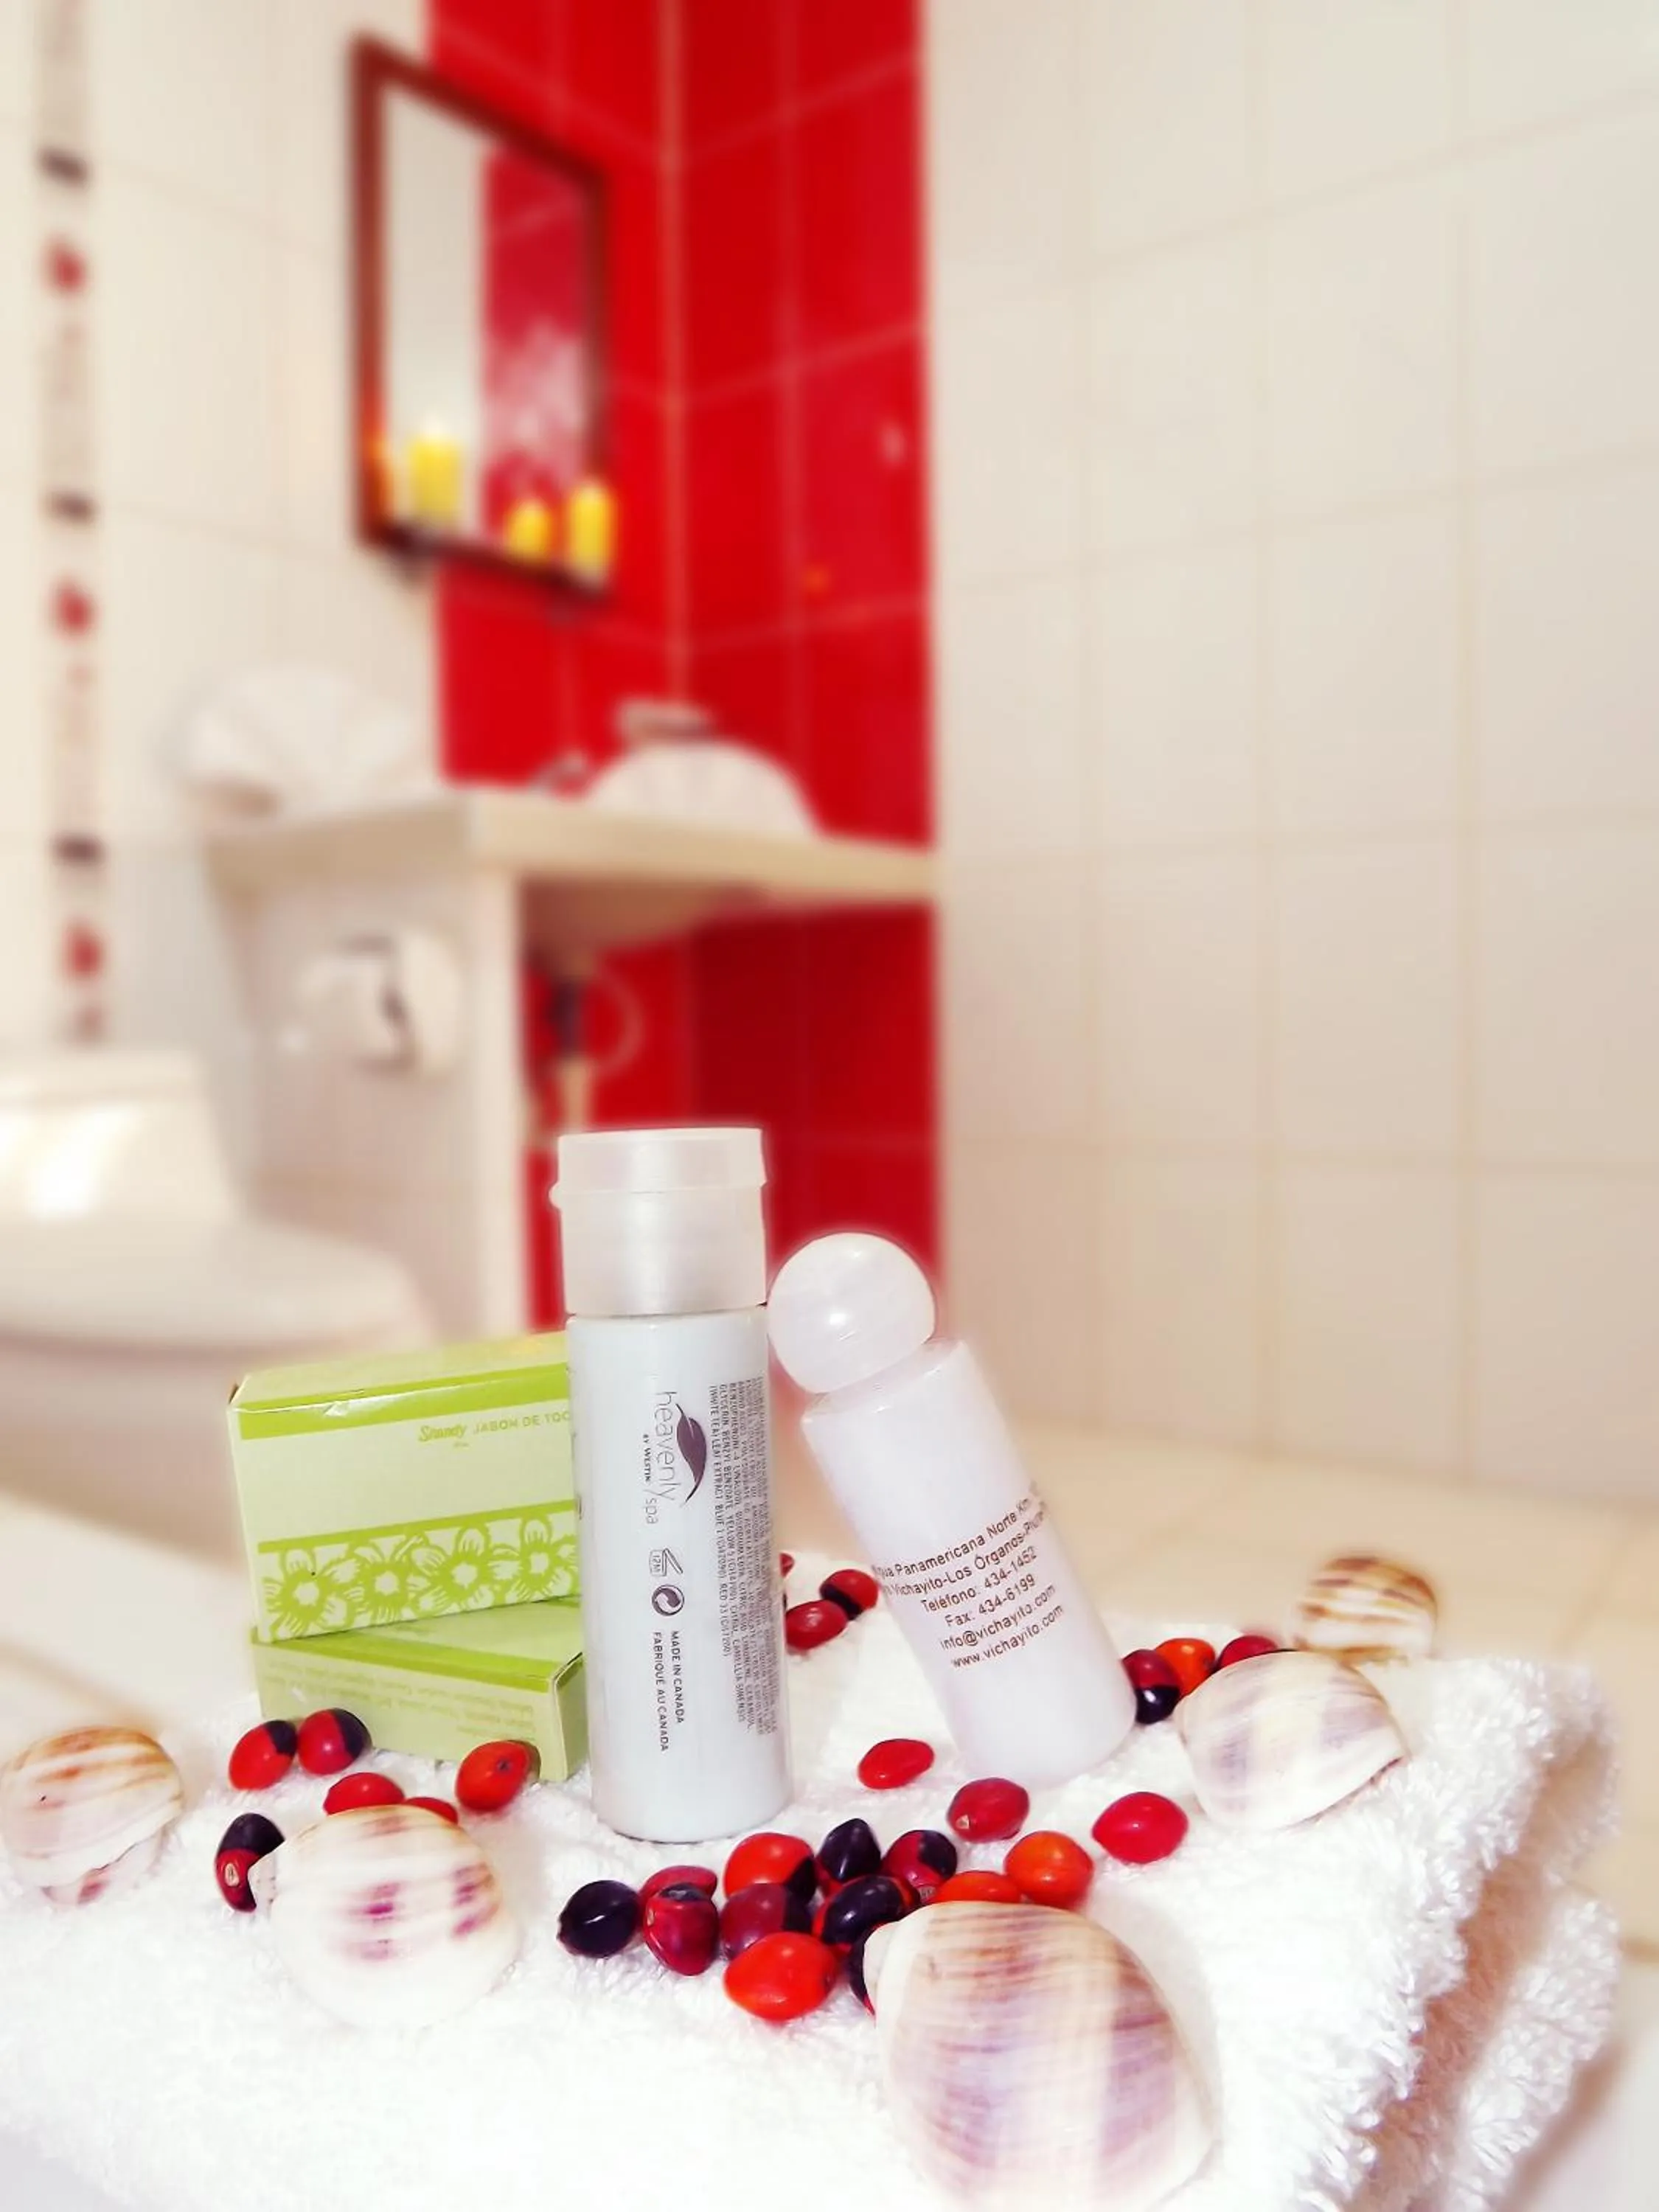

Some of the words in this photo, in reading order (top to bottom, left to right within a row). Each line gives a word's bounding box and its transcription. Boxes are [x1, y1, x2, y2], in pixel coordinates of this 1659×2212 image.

[522, 1414, 541, 1427] DE
[643, 1434, 650, 1444] BY
[644, 1391, 681, 1500] heavenly
[644, 1447, 652, 1484] WESTIN
[645, 1498, 659, 1524] spa
[714, 1504, 723, 1525] BLUE
[894, 1534, 986, 1576] Panamericana
[986, 1512, 1018, 1539] Norte
[984, 1545, 1038, 1590] 434-1452
[940, 1585, 1056, 1651] info@vichayito.com
[945, 1610, 975, 1627] Fax:
[978, 1573, 1036, 1615] 434-6199
[653, 1632, 665, 1685] FABRIQUE
[671, 1631, 681, 1661] MADE
[950, 1604, 1064, 1669] www.vichayito.com
[672, 1664, 682, 1676] IN
[657, 1689, 666, 1704] AU
[673, 1678, 685, 1724] CANADA
[657, 1706, 669, 1752] CANADA
